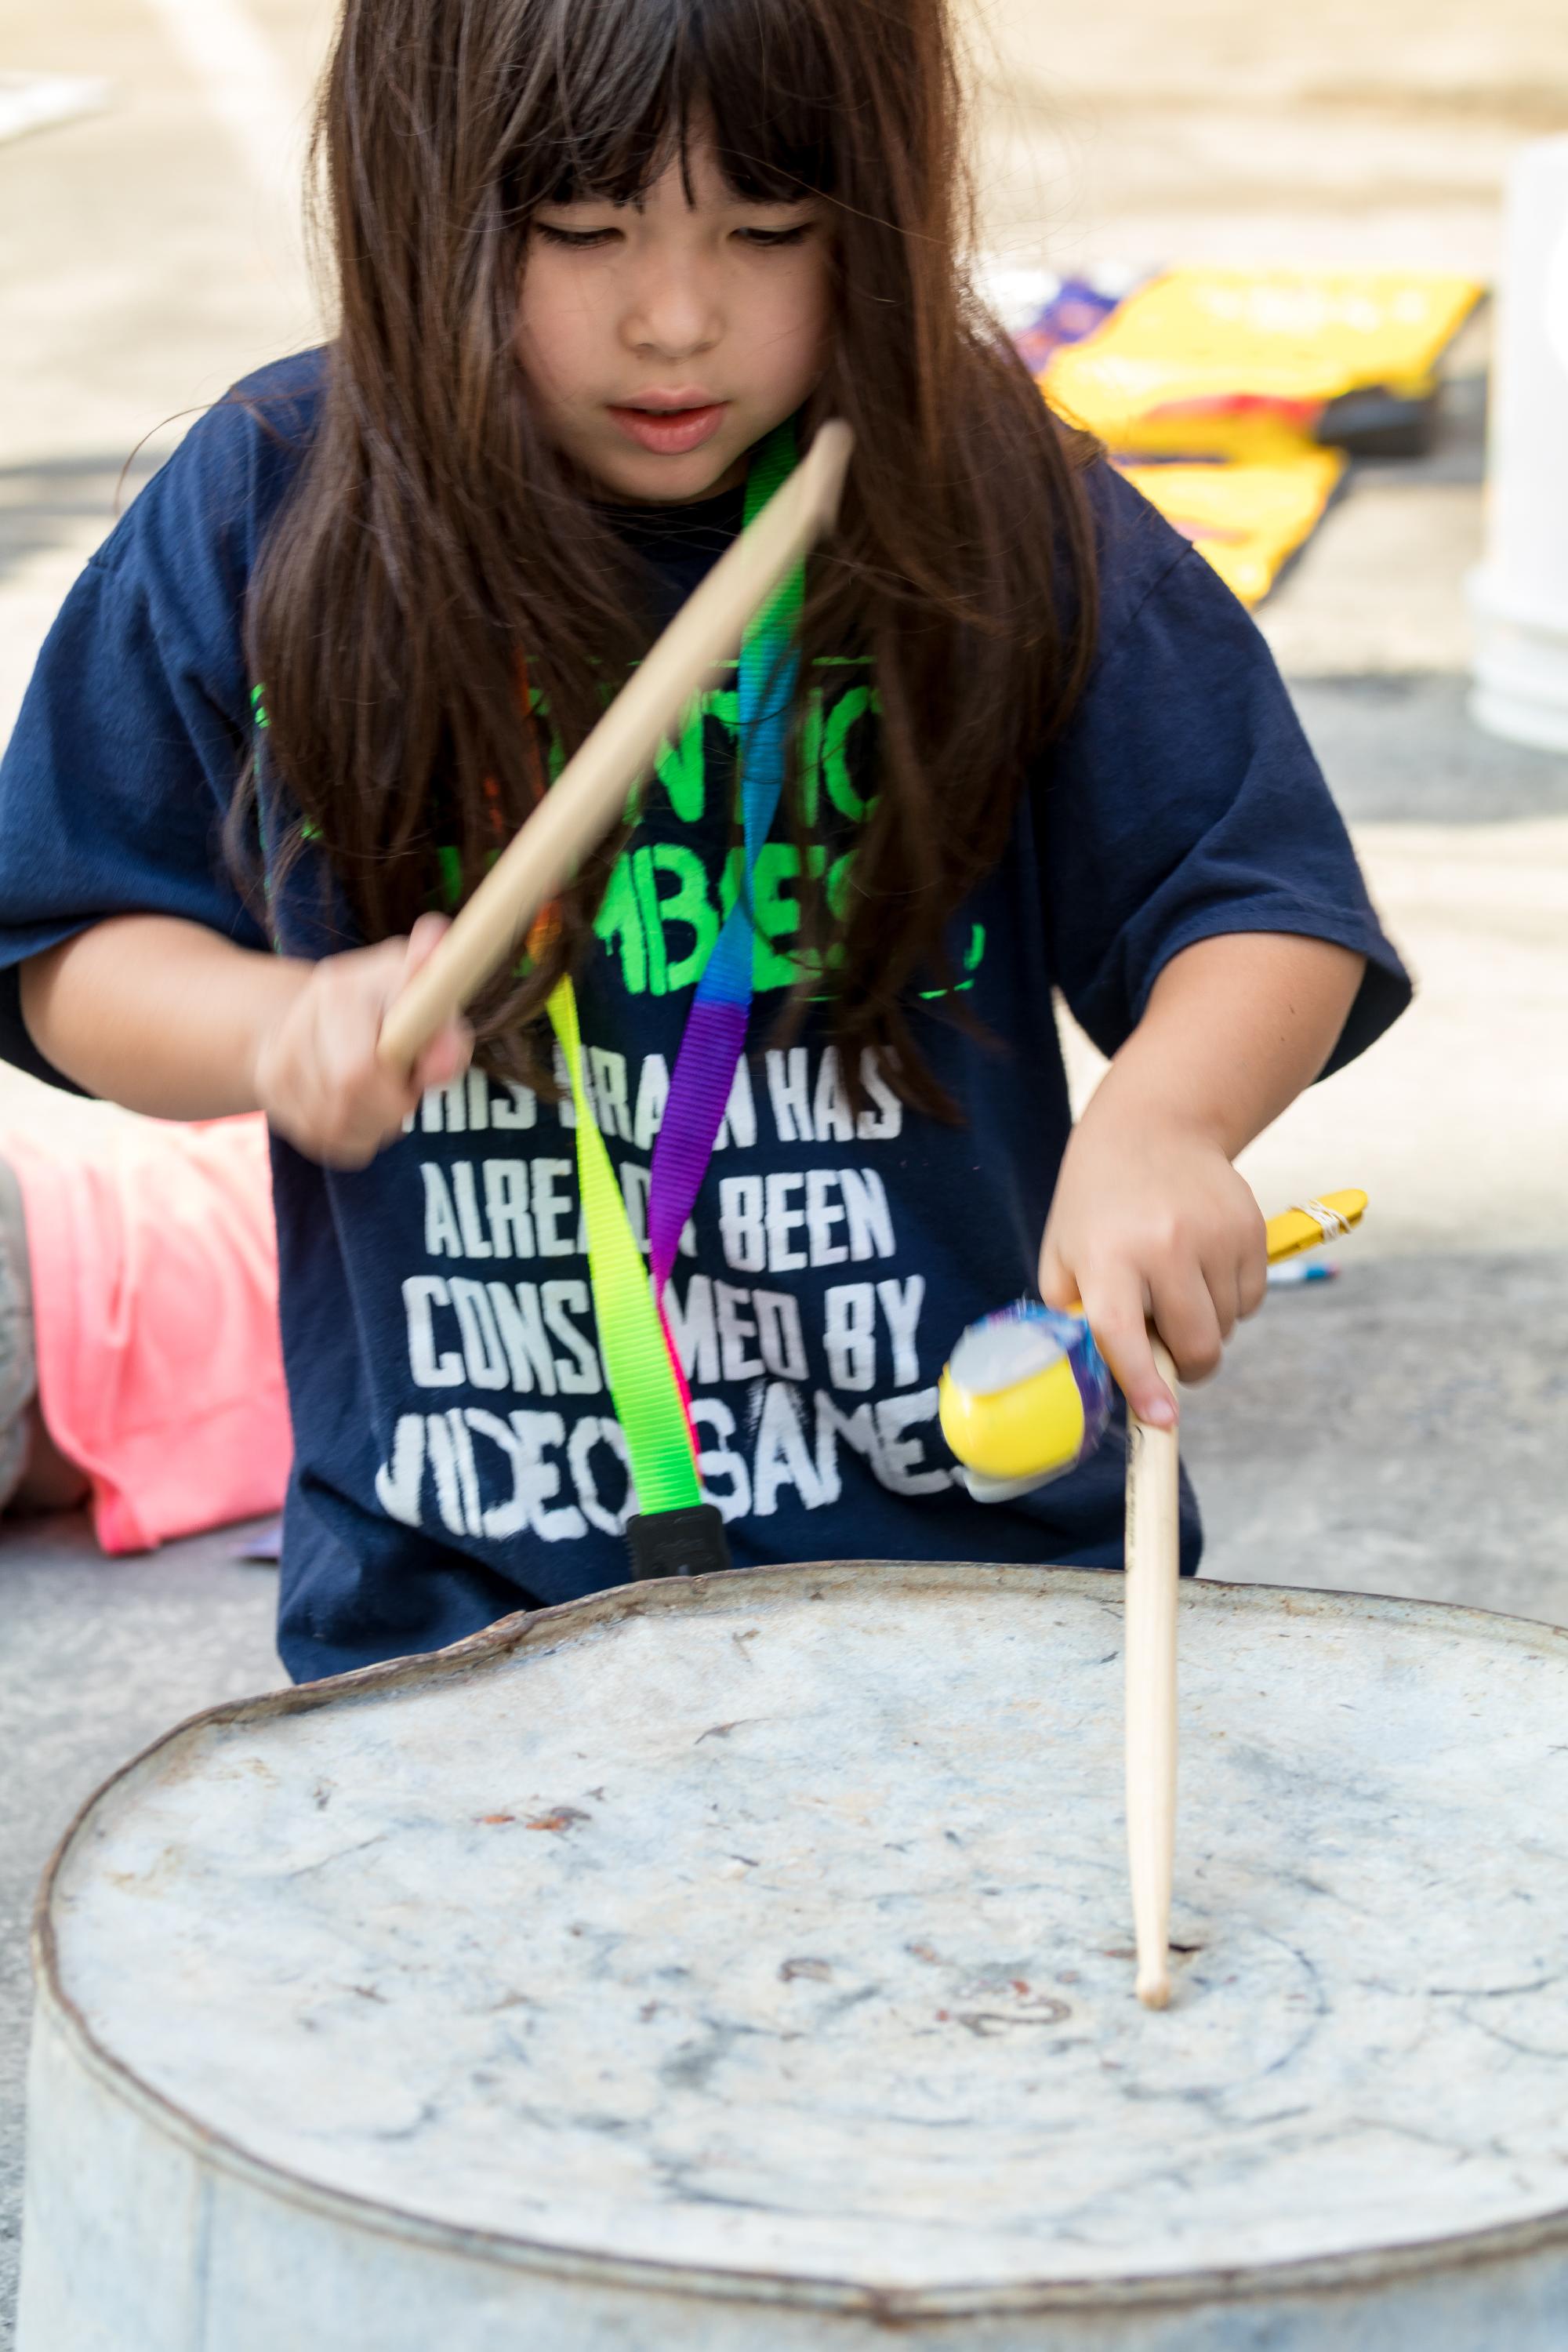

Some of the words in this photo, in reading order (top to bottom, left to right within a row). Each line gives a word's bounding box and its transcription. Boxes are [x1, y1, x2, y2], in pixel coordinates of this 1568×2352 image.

[401, 1065, 536, 1133] HIS
[554, 1044, 757, 1151] BRAN
[764, 1045, 902, 1142] HAS
[420, 1157, 698, 1258] ALRED
[720, 1167, 895, 1272] BEEN
[402, 1275, 809, 1396] CONSMED
[823, 1275, 925, 1392] BY
[689, 1380, 967, 1526] GAME
